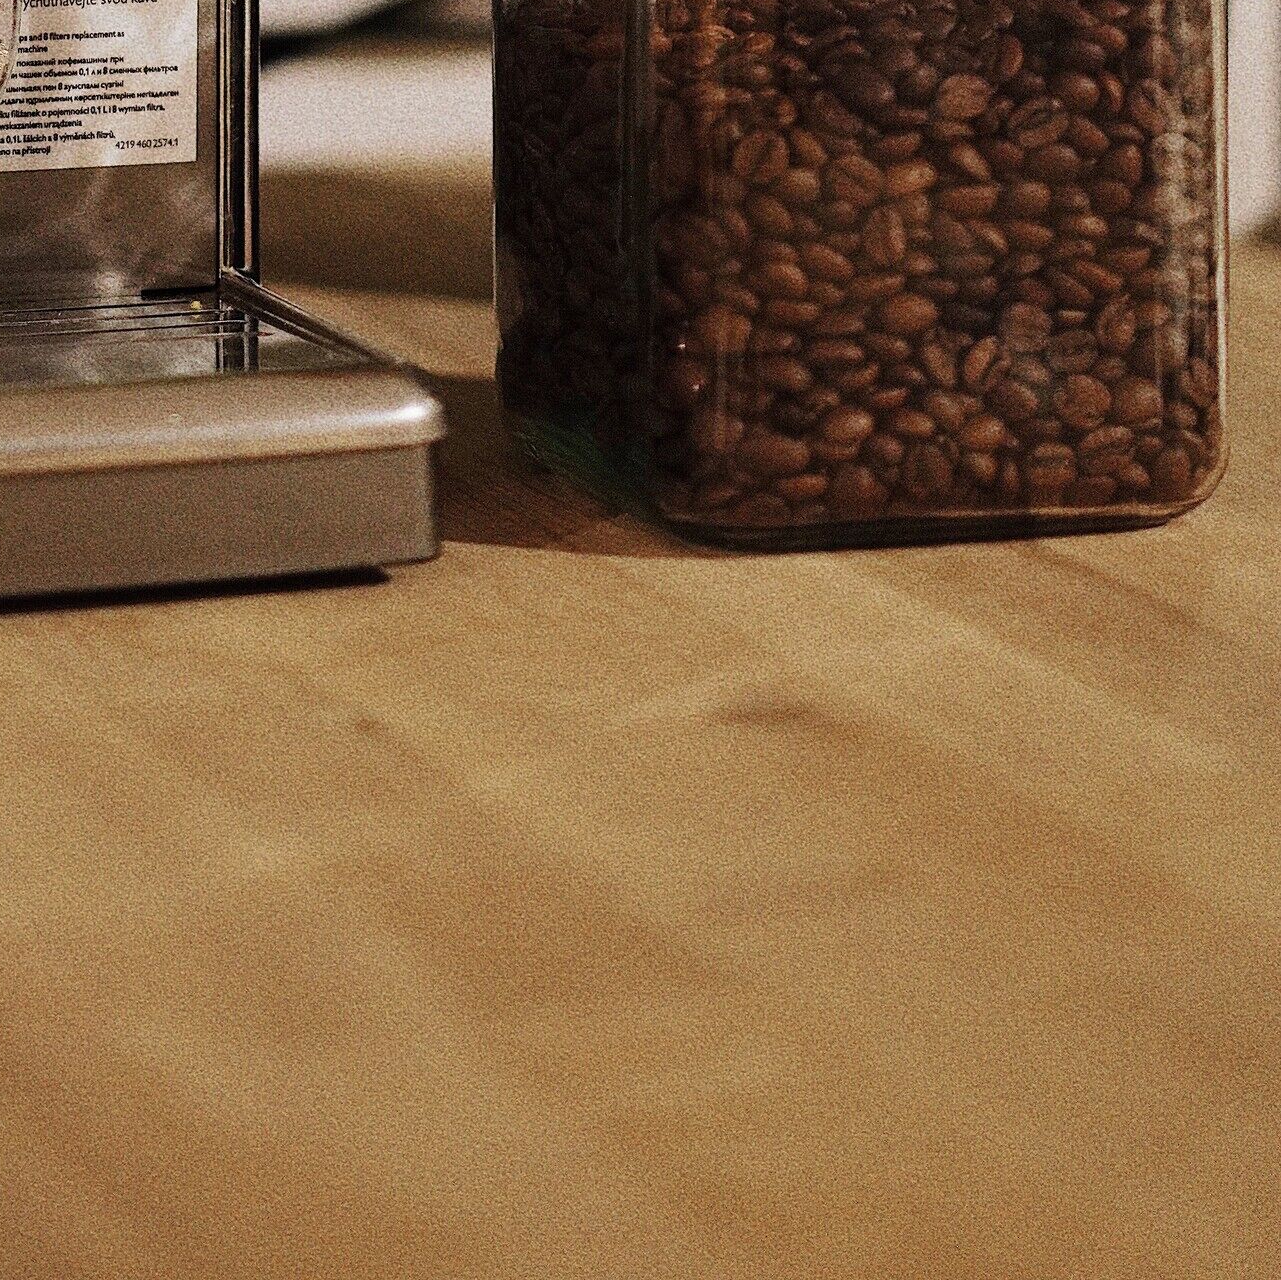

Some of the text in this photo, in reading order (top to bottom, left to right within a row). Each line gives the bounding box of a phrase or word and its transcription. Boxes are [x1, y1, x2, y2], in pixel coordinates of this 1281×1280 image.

[72, 31, 116, 40] replacement
[116, 141, 134, 150] 4219
[136, 140, 151, 148] 460
